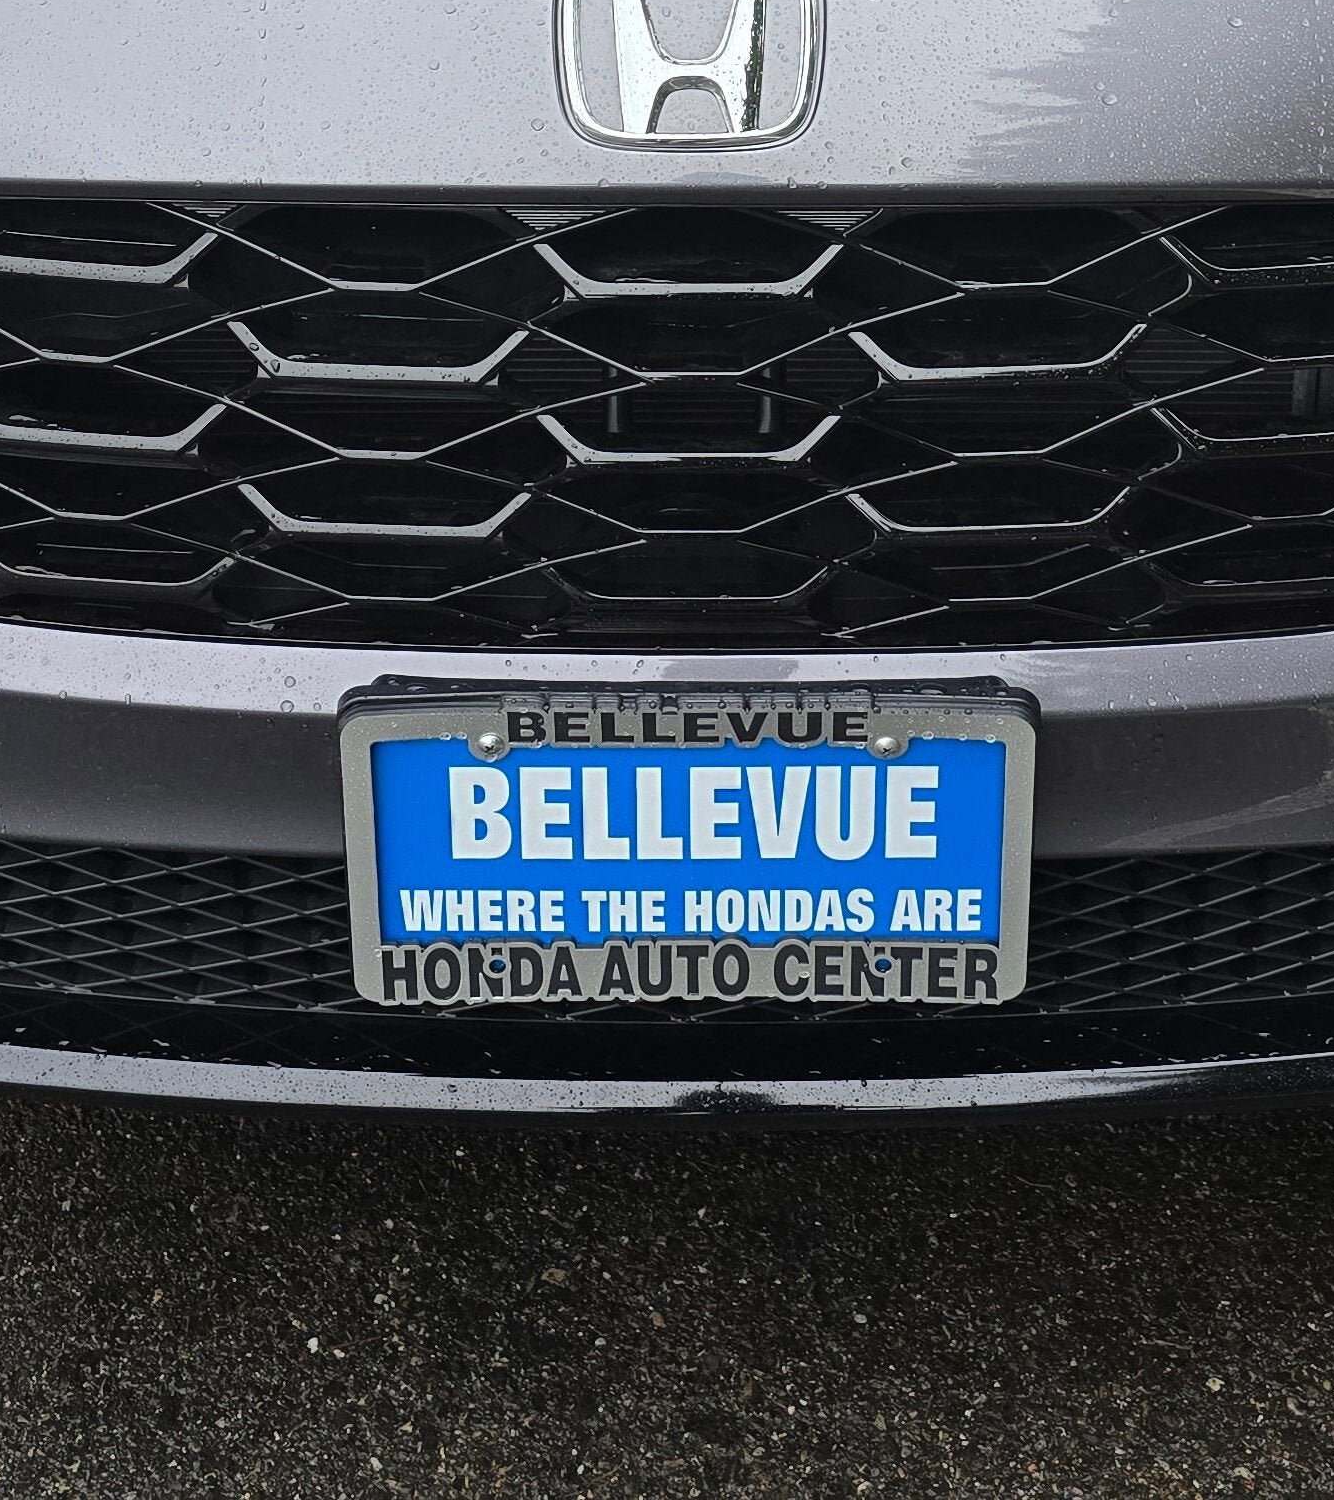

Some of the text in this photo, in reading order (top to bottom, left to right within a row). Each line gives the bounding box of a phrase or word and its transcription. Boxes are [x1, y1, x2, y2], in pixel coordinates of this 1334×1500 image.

[506, 711, 869, 744] BELLEVUE
[448, 765, 940, 861] BELLEVUE
[400, 888, 983, 933] WHERE THE HONDAS ARE
[381, 945, 999, 1002] HONDA AUTO CENTER
